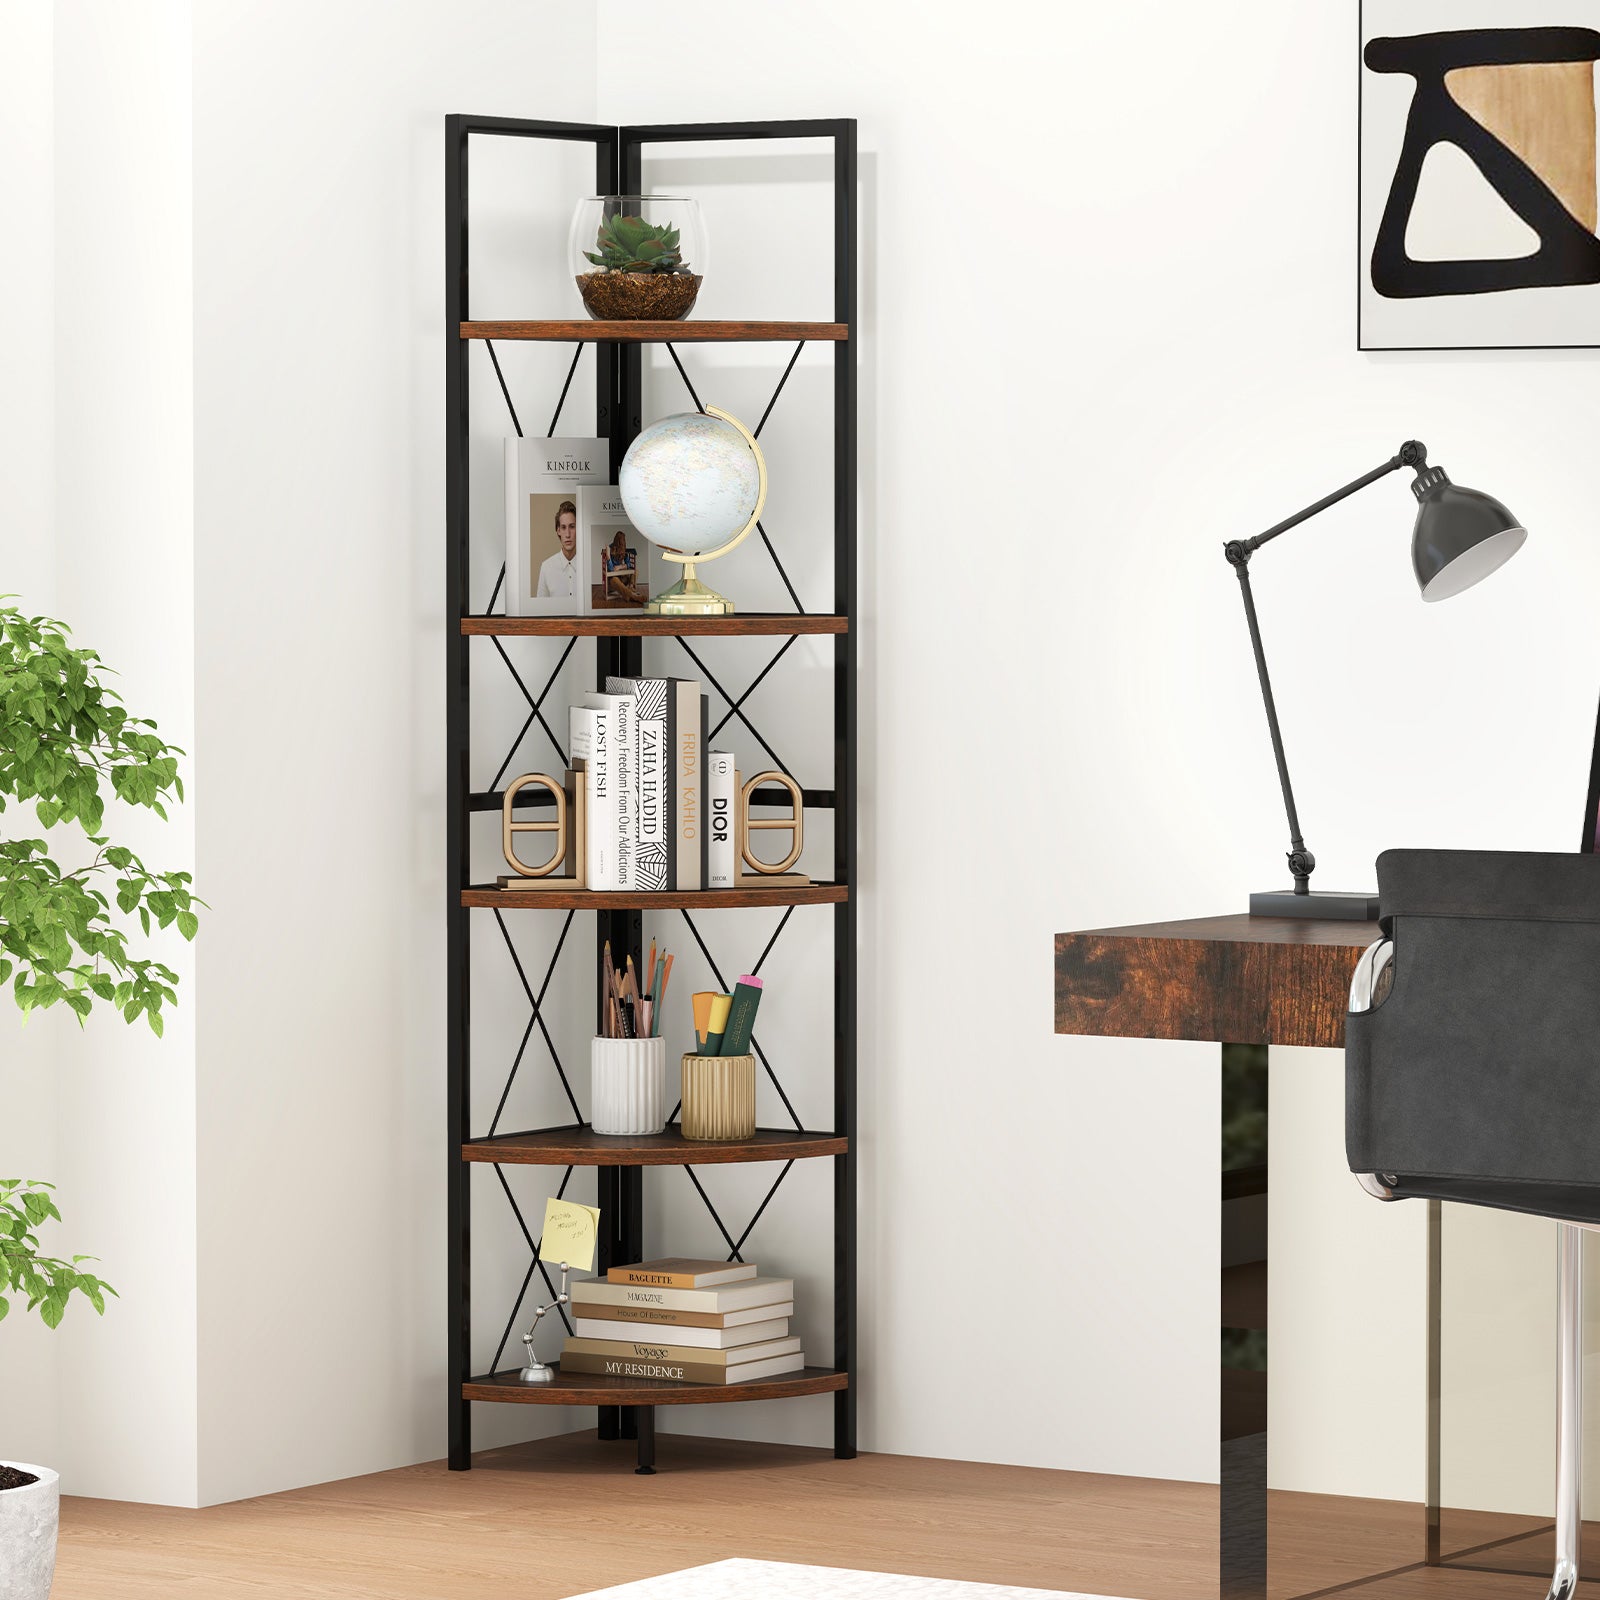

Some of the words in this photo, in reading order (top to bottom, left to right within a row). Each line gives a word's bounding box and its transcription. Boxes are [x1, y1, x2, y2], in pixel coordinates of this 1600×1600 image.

[547, 461, 591, 471] KINFOLK
[602, 502, 625, 510] KINF
[596, 715, 607, 756] LOST
[614, 701, 630, 746] Recovery.
[619, 748, 631, 788] Freedom
[643, 730, 657, 776] ZAHA
[682, 733, 696, 777] FRIDA
[596, 762, 607, 798] FISH
[619, 791, 630, 814] From
[643, 780, 657, 834] HADID
[682, 787, 696, 840] KAHLO
[712, 798, 728, 842] DIOR
[618, 816, 631, 834] Our
[618, 836, 631, 885] Addictions
[629, 1273, 673, 1284] BAGUETTE
[617, 1309, 638, 1319] House
[639, 1311, 649, 1319] Of
[627, 1291, 664, 1304] MAGAZINE
[633, 1344, 669, 1359] Voyage
[605, 1361, 623, 1375] MY
[624, 1363, 684, 1379] RESIDENCE
